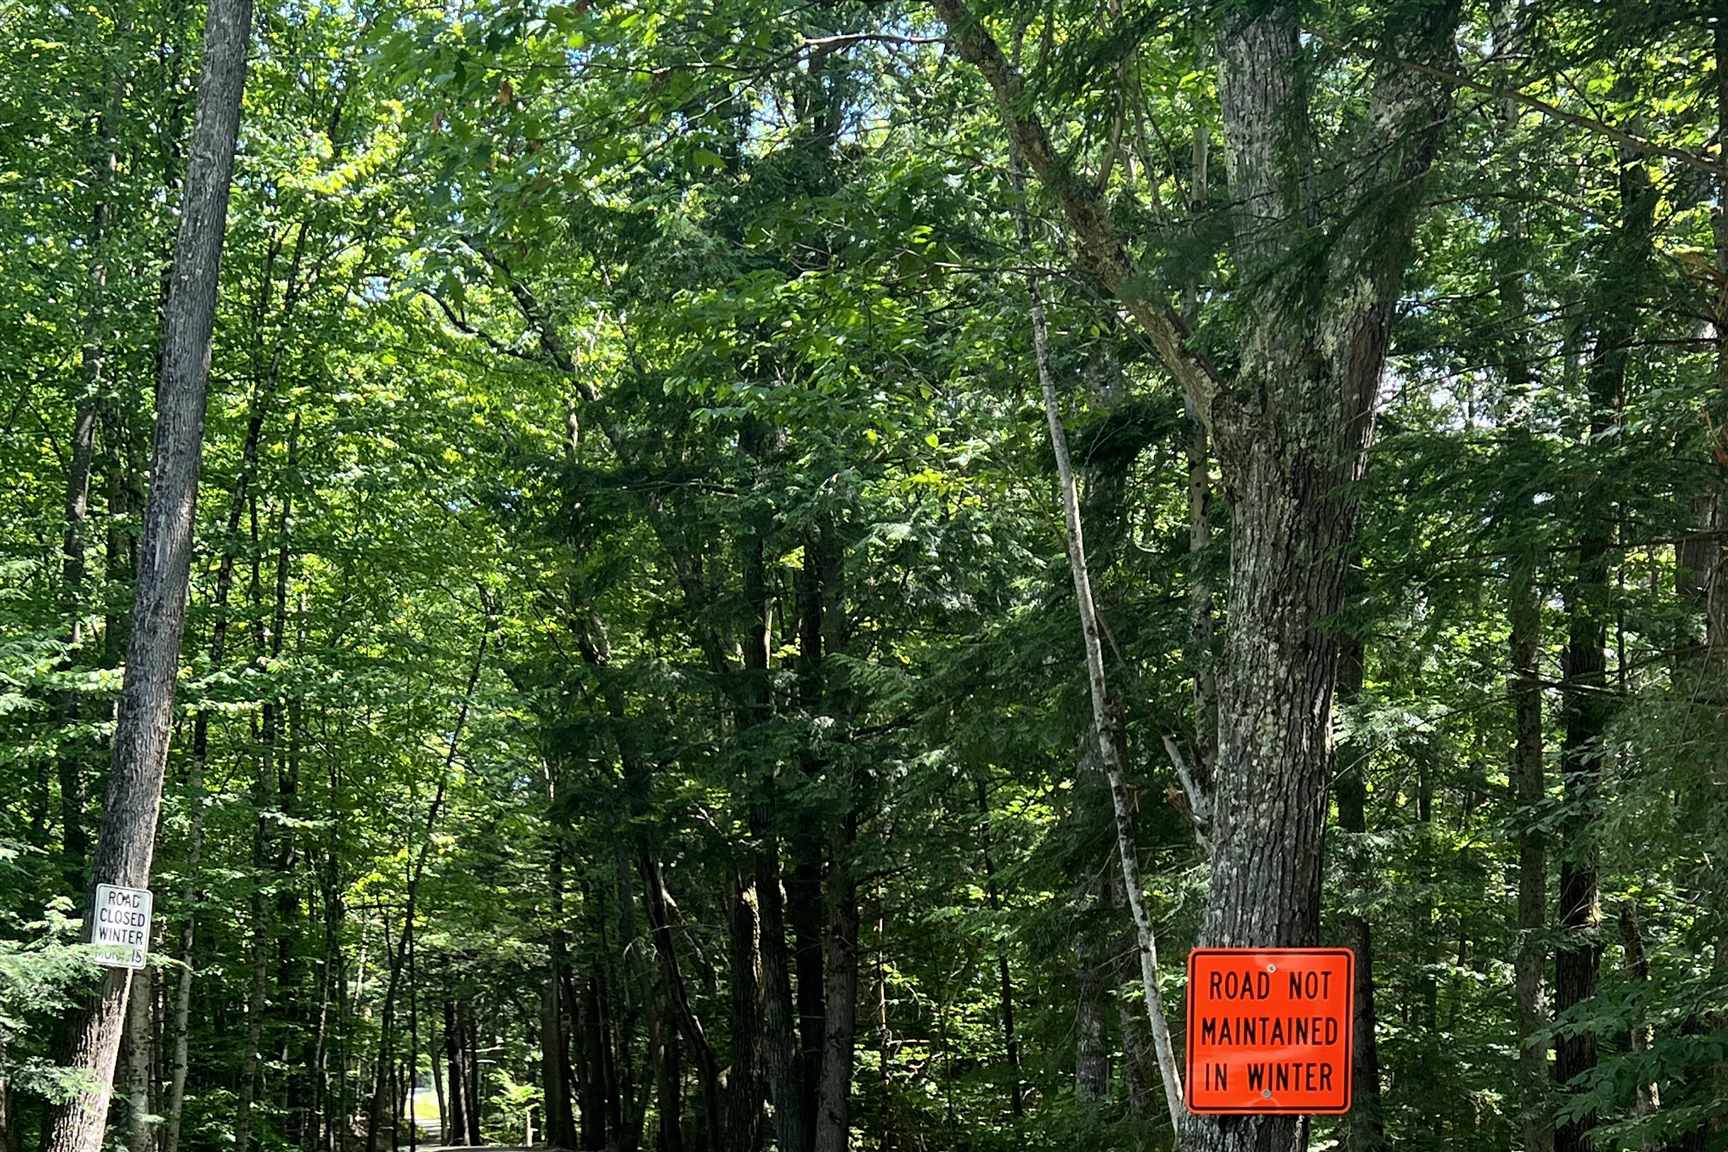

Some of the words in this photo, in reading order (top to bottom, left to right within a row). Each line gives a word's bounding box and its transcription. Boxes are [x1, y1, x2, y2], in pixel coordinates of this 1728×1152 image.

[108, 891, 141, 908] ROAD
[100, 908, 146, 927] CLOSED
[99, 927, 143, 945] WINTER
[1209, 971, 1270, 1000] ROAD
[1289, 971, 1332, 1000] NOT
[1201, 1017, 1338, 1046] MAINTAINED
[1205, 1063, 1228, 1092] IN
[1247, 1063, 1333, 1092] WINTER
